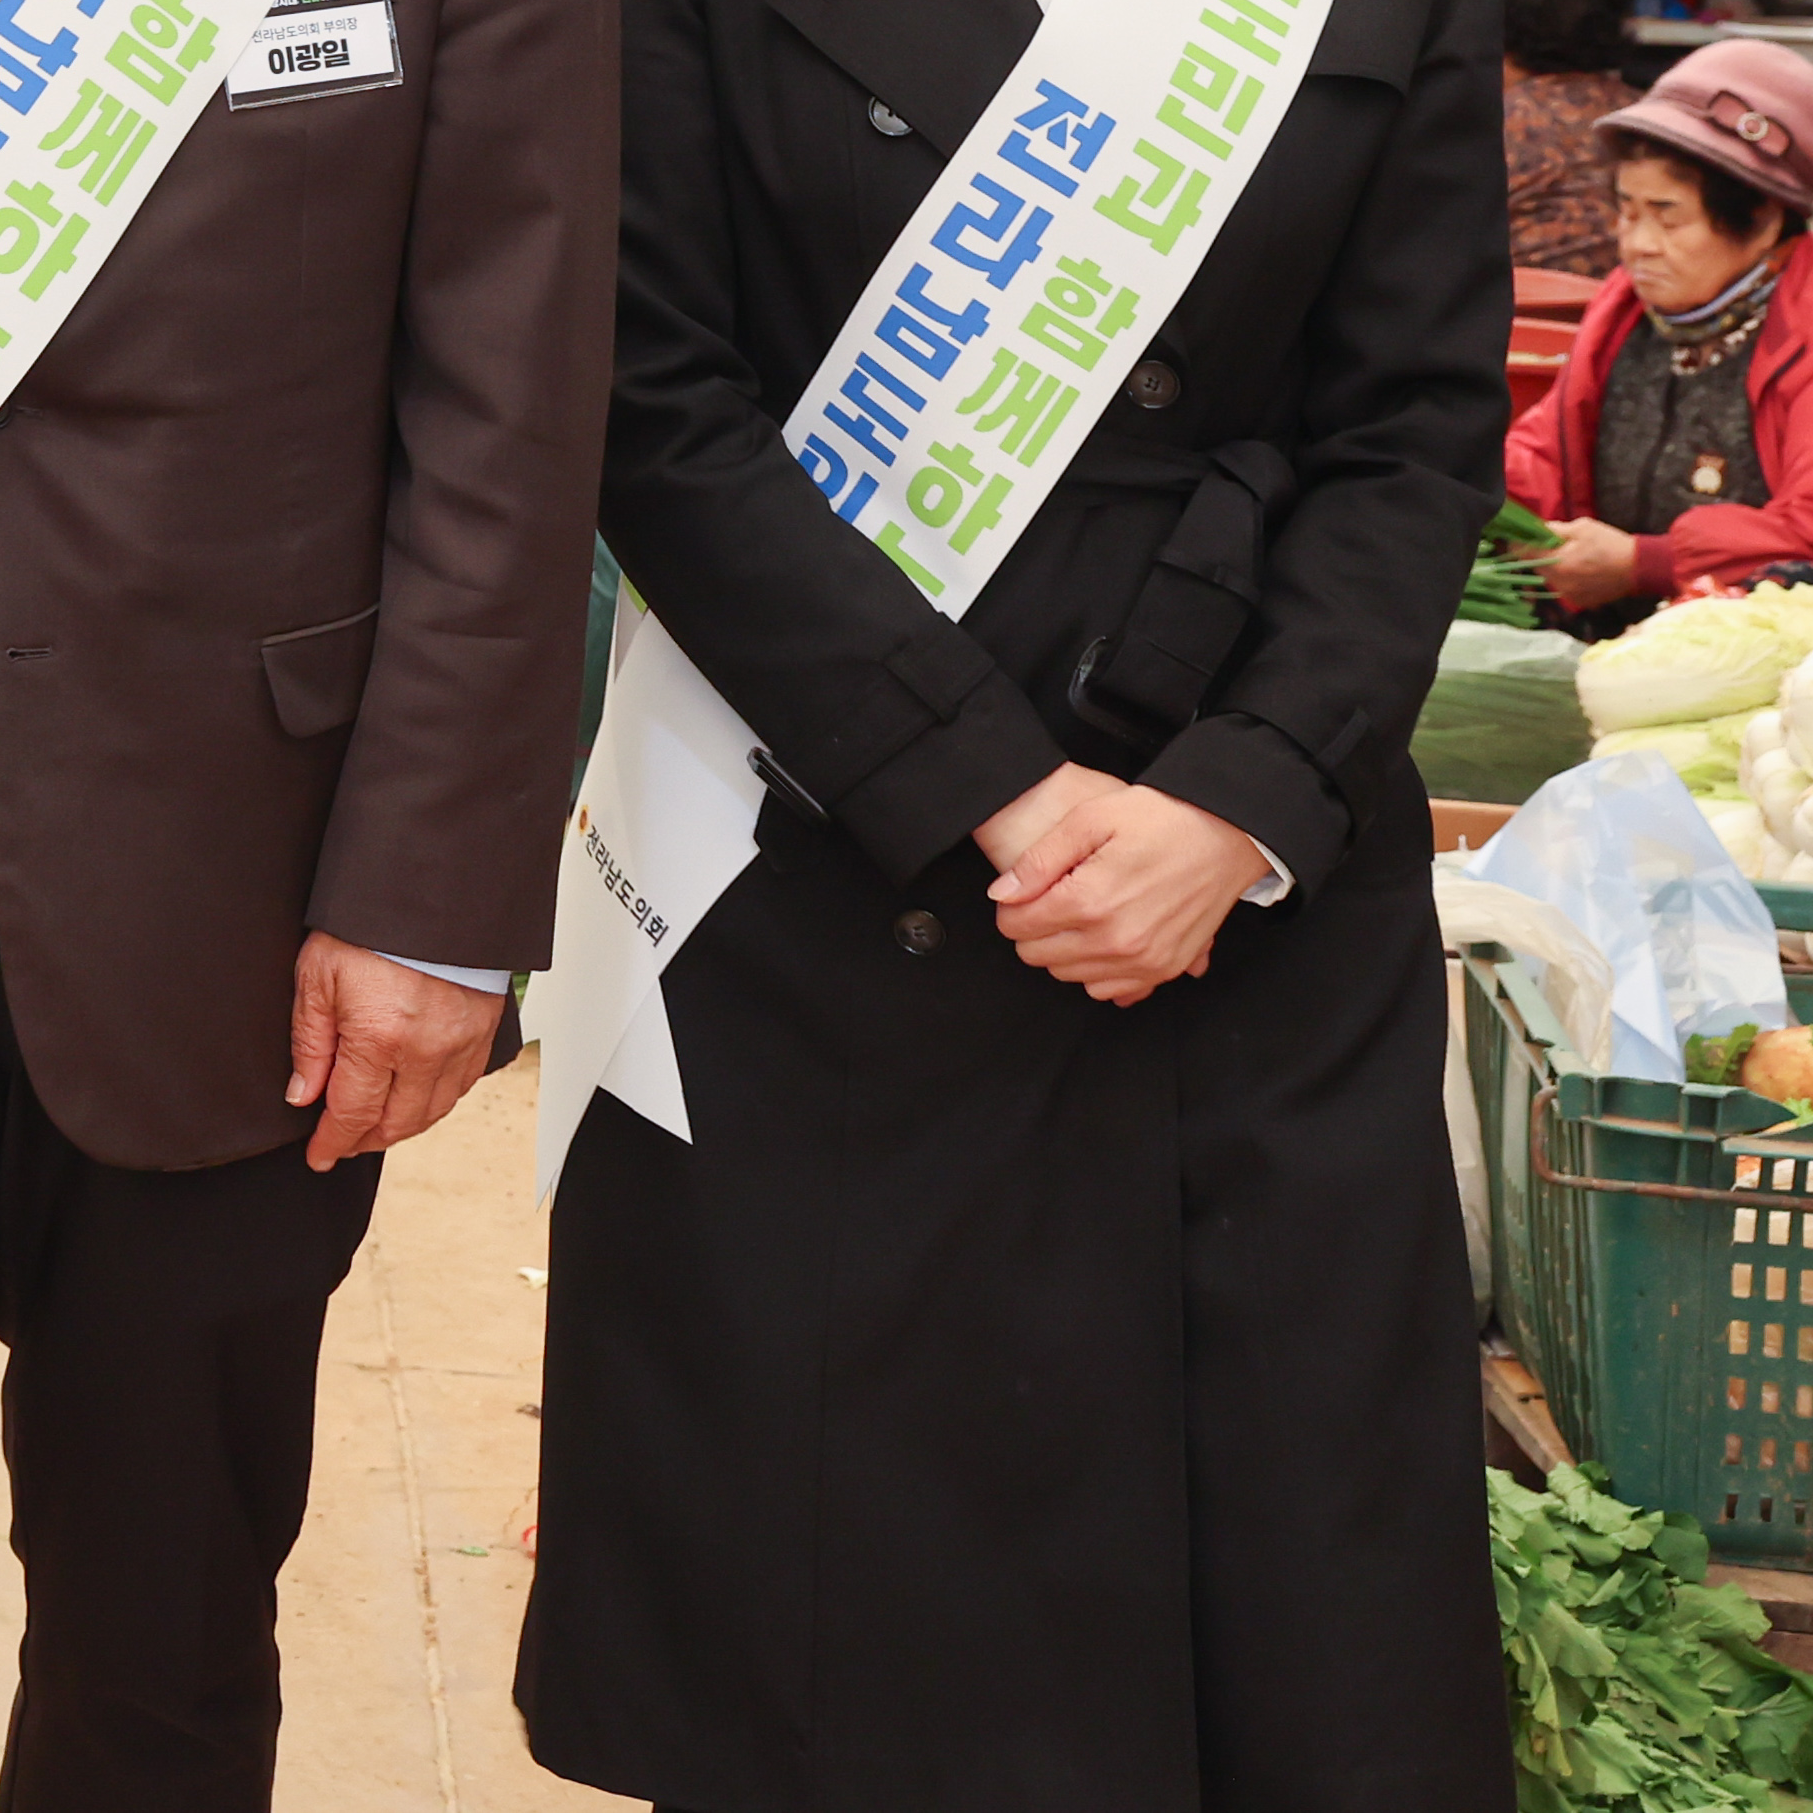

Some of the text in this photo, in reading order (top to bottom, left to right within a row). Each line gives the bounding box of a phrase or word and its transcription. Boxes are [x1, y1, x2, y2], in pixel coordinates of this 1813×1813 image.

[322, 16, 359, 34] 부의장
[267, 37, 352, 76] 이광일
[583, 823, 670, 949] 전라남도의회
